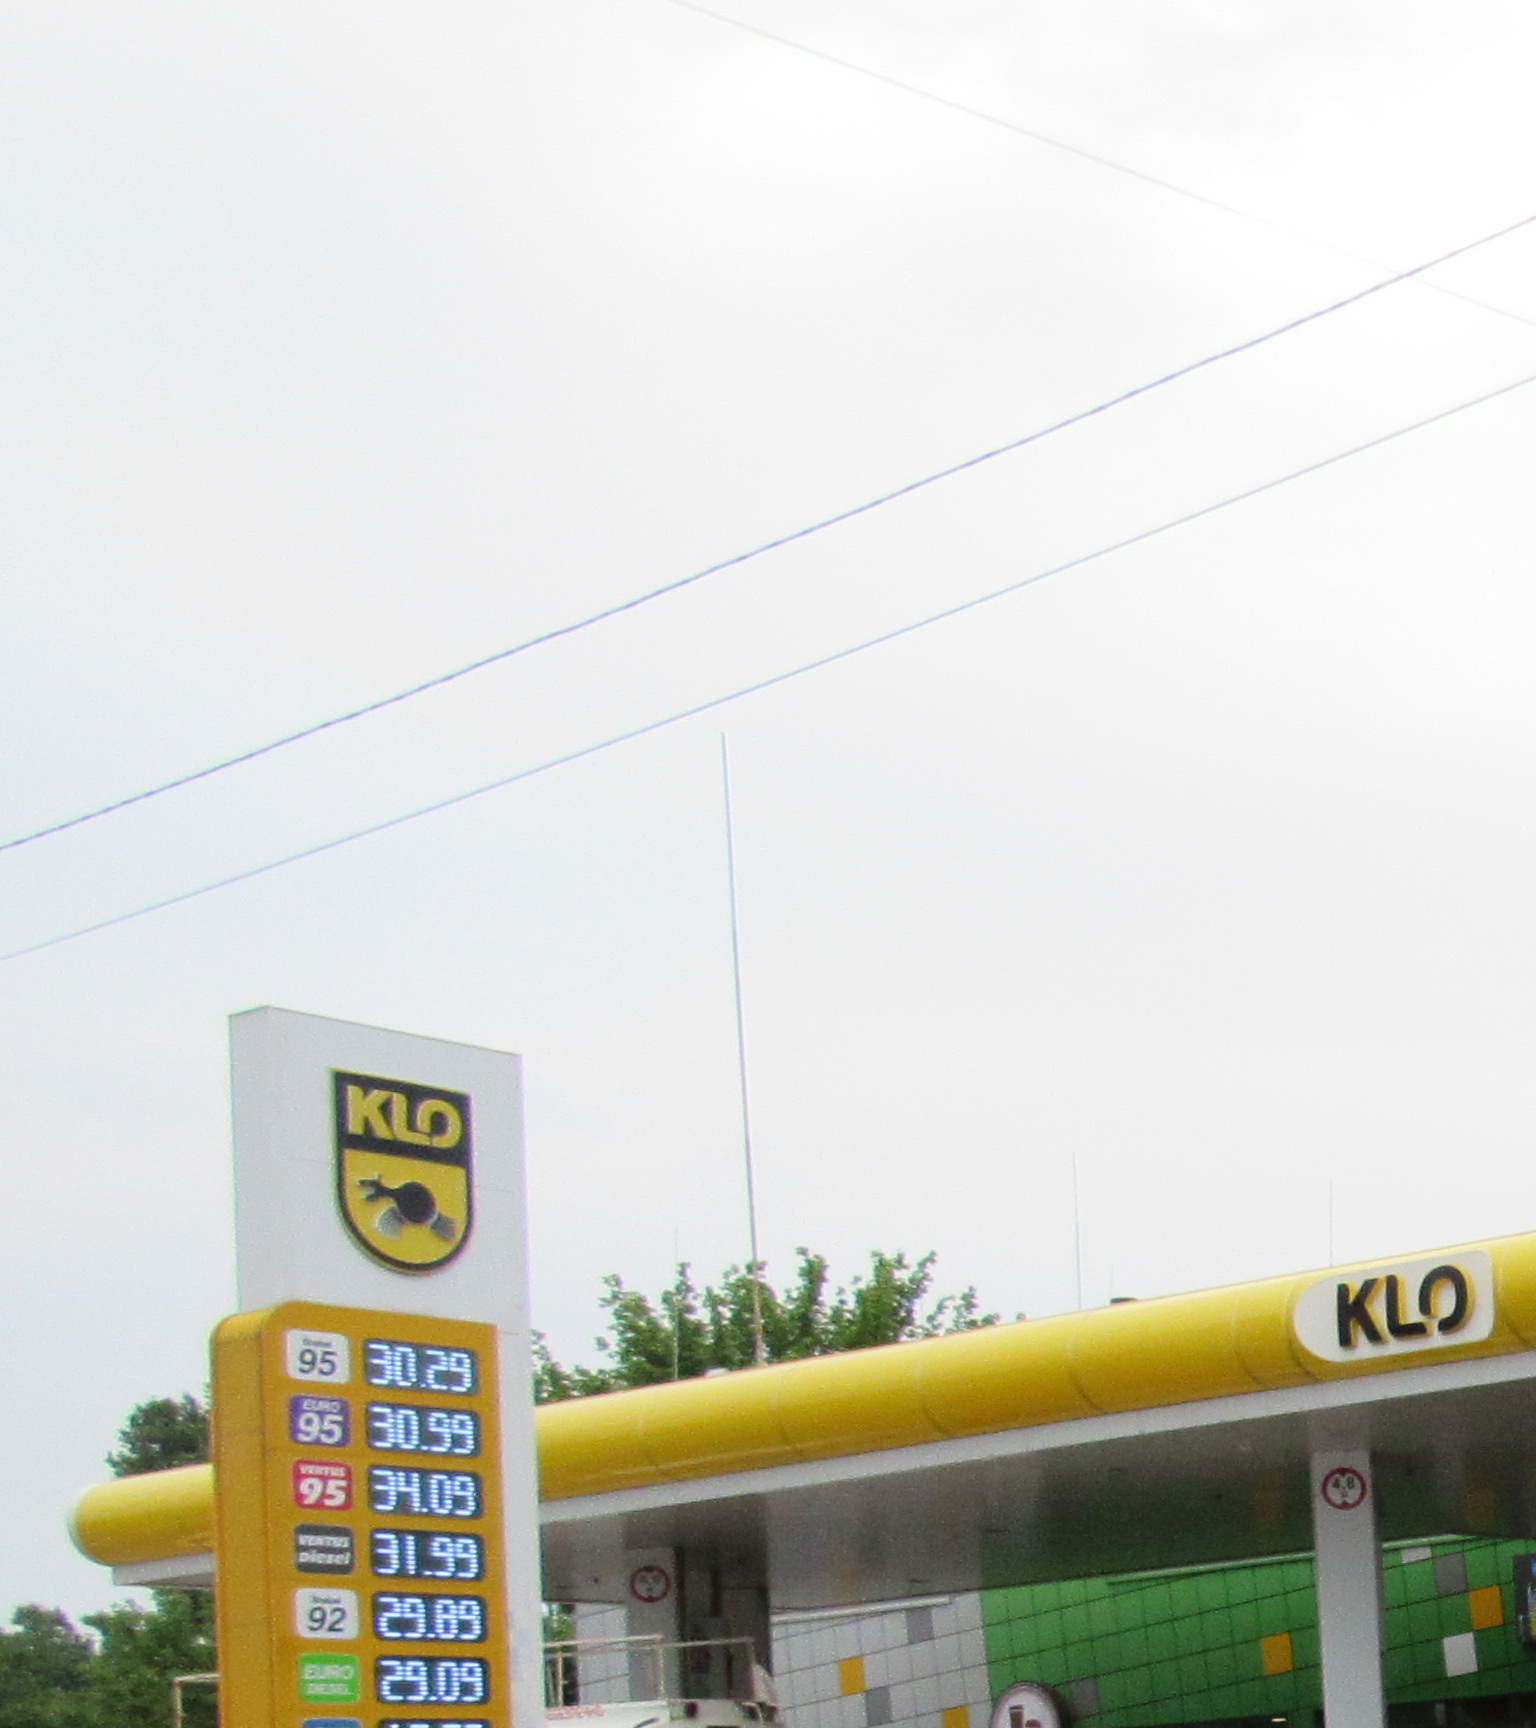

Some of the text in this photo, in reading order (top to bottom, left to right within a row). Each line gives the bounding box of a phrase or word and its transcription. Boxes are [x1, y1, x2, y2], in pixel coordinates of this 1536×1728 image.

[345, 1084, 464, 1150] KLO
[1336, 1264, 1474, 1350] KLO
[298, 1348, 337, 1376] 95
[368, 1343, 471, 1392] 30.29
[297, 1412, 343, 1445] 95
[370, 1406, 474, 1455] 30.99
[301, 1477, 348, 1507] 95
[371, 1469, 475, 1516] 34.09
[373, 1532, 479, 1579] 31.99
[307, 1606, 346, 1632] 92
[376, 1596, 482, 1640] 29.89
[379, 1659, 484, 1702] 29.09
